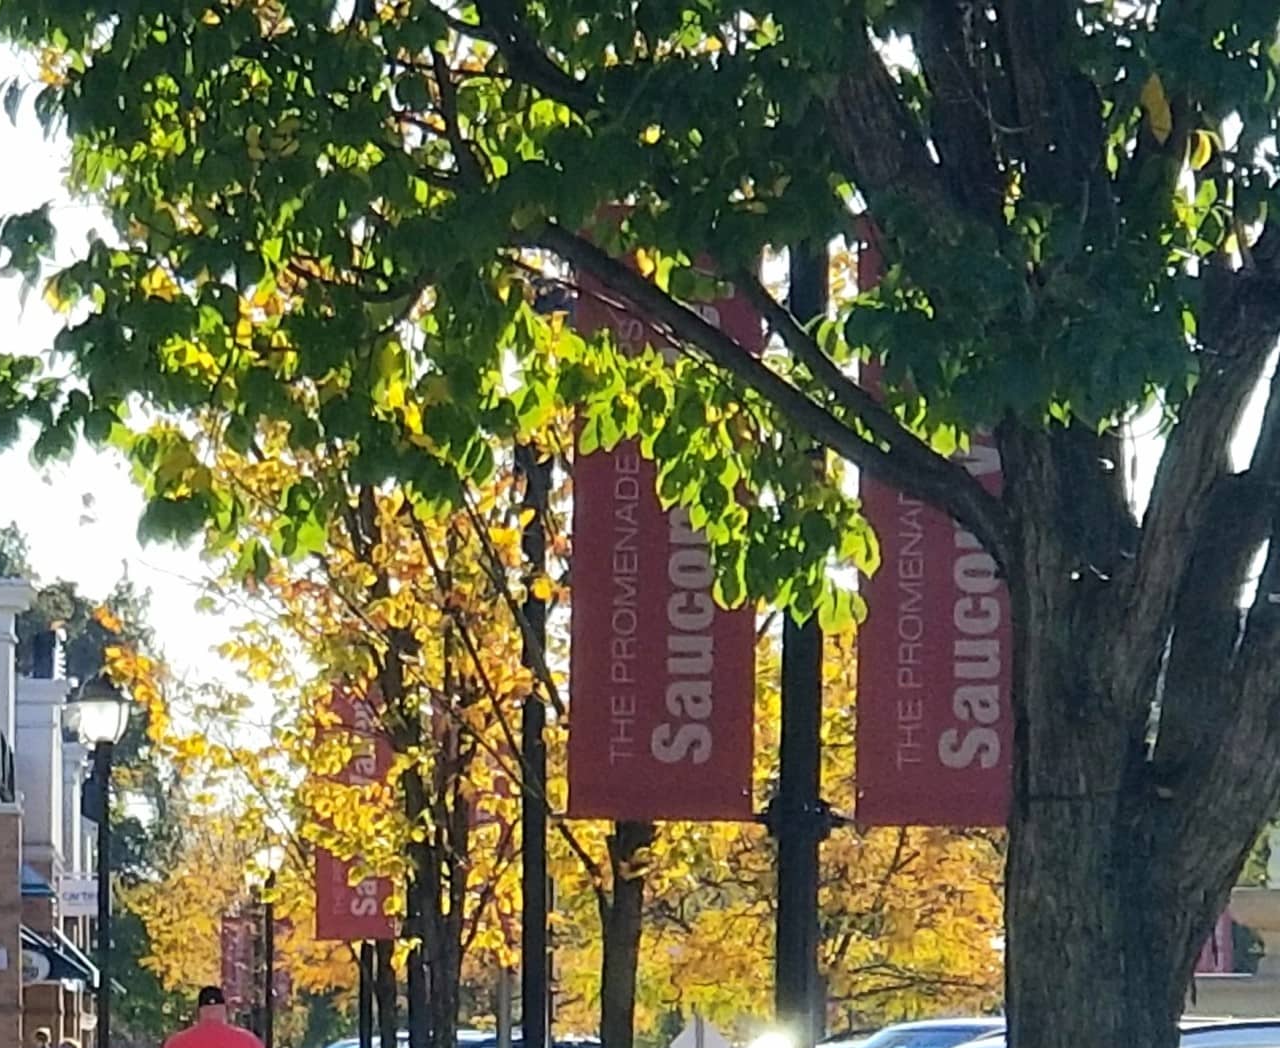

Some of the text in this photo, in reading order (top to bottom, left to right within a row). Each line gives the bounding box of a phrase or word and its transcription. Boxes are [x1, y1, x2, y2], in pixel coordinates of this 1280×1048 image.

[609, 455, 641, 766] THE PROMENADE
[897, 491, 925, 771] THE PROMENA
